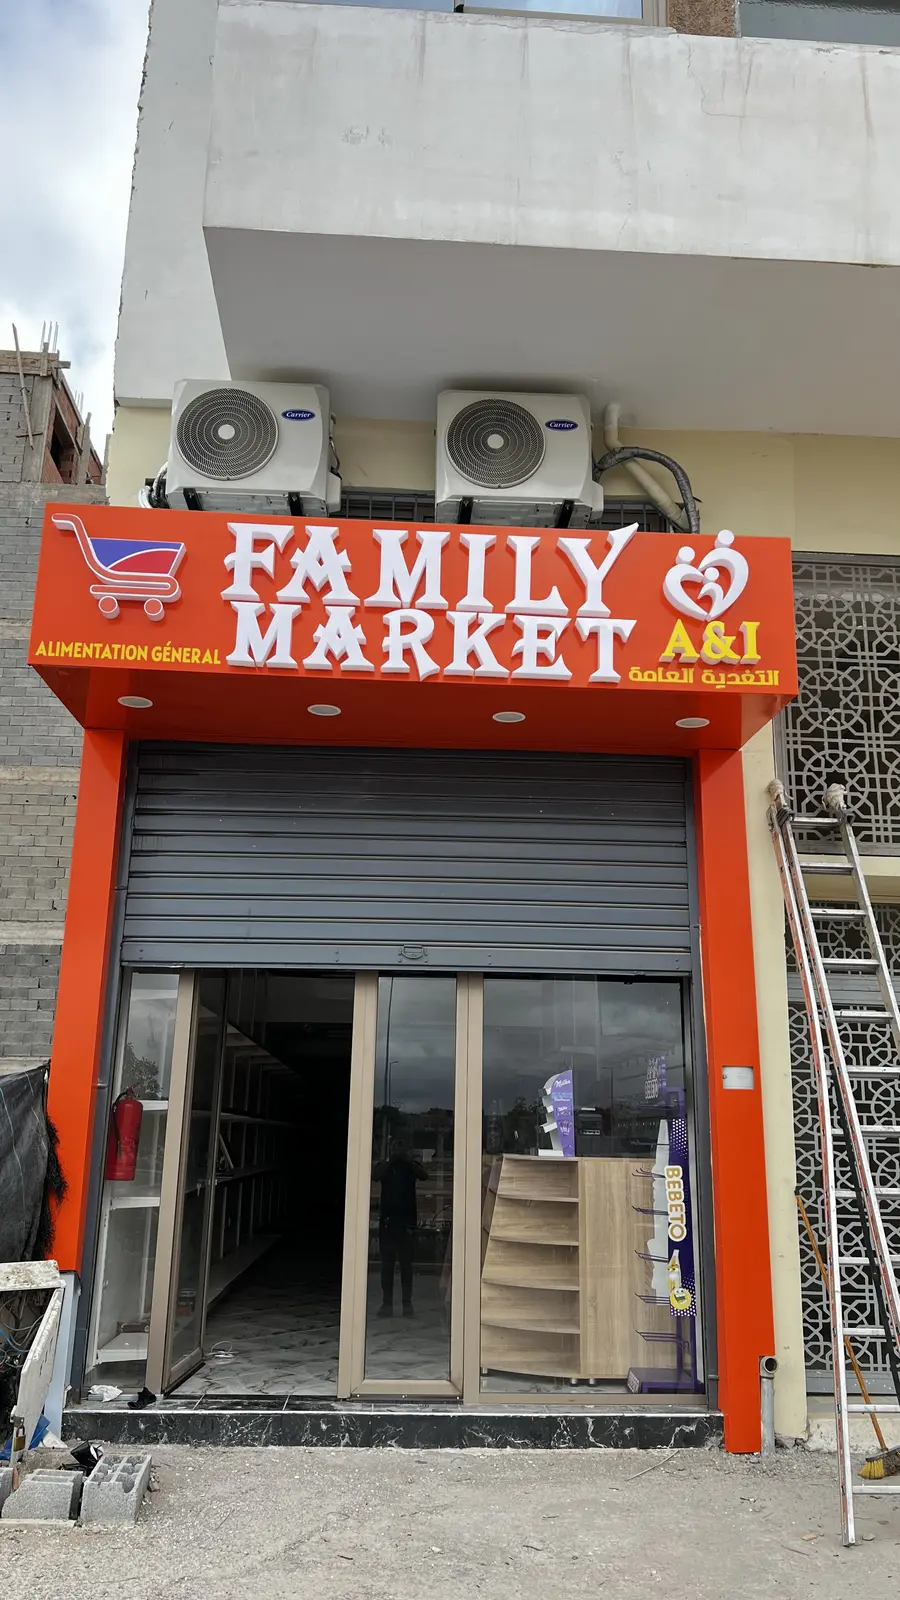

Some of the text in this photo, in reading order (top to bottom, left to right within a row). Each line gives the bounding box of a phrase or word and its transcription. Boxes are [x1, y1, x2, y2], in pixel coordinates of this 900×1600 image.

[549, 421, 574, 429] Carrier
[220, 522, 639, 617] FAMILY
[35, 640, 221, 665] ALIMENTATION GÉNERAL
[225, 600, 637, 683] MARKET
[659, 618, 761, 665] A&I
[628, 666, 695, 684] العامة
[664, 1165, 687, 1242] BEBETO
